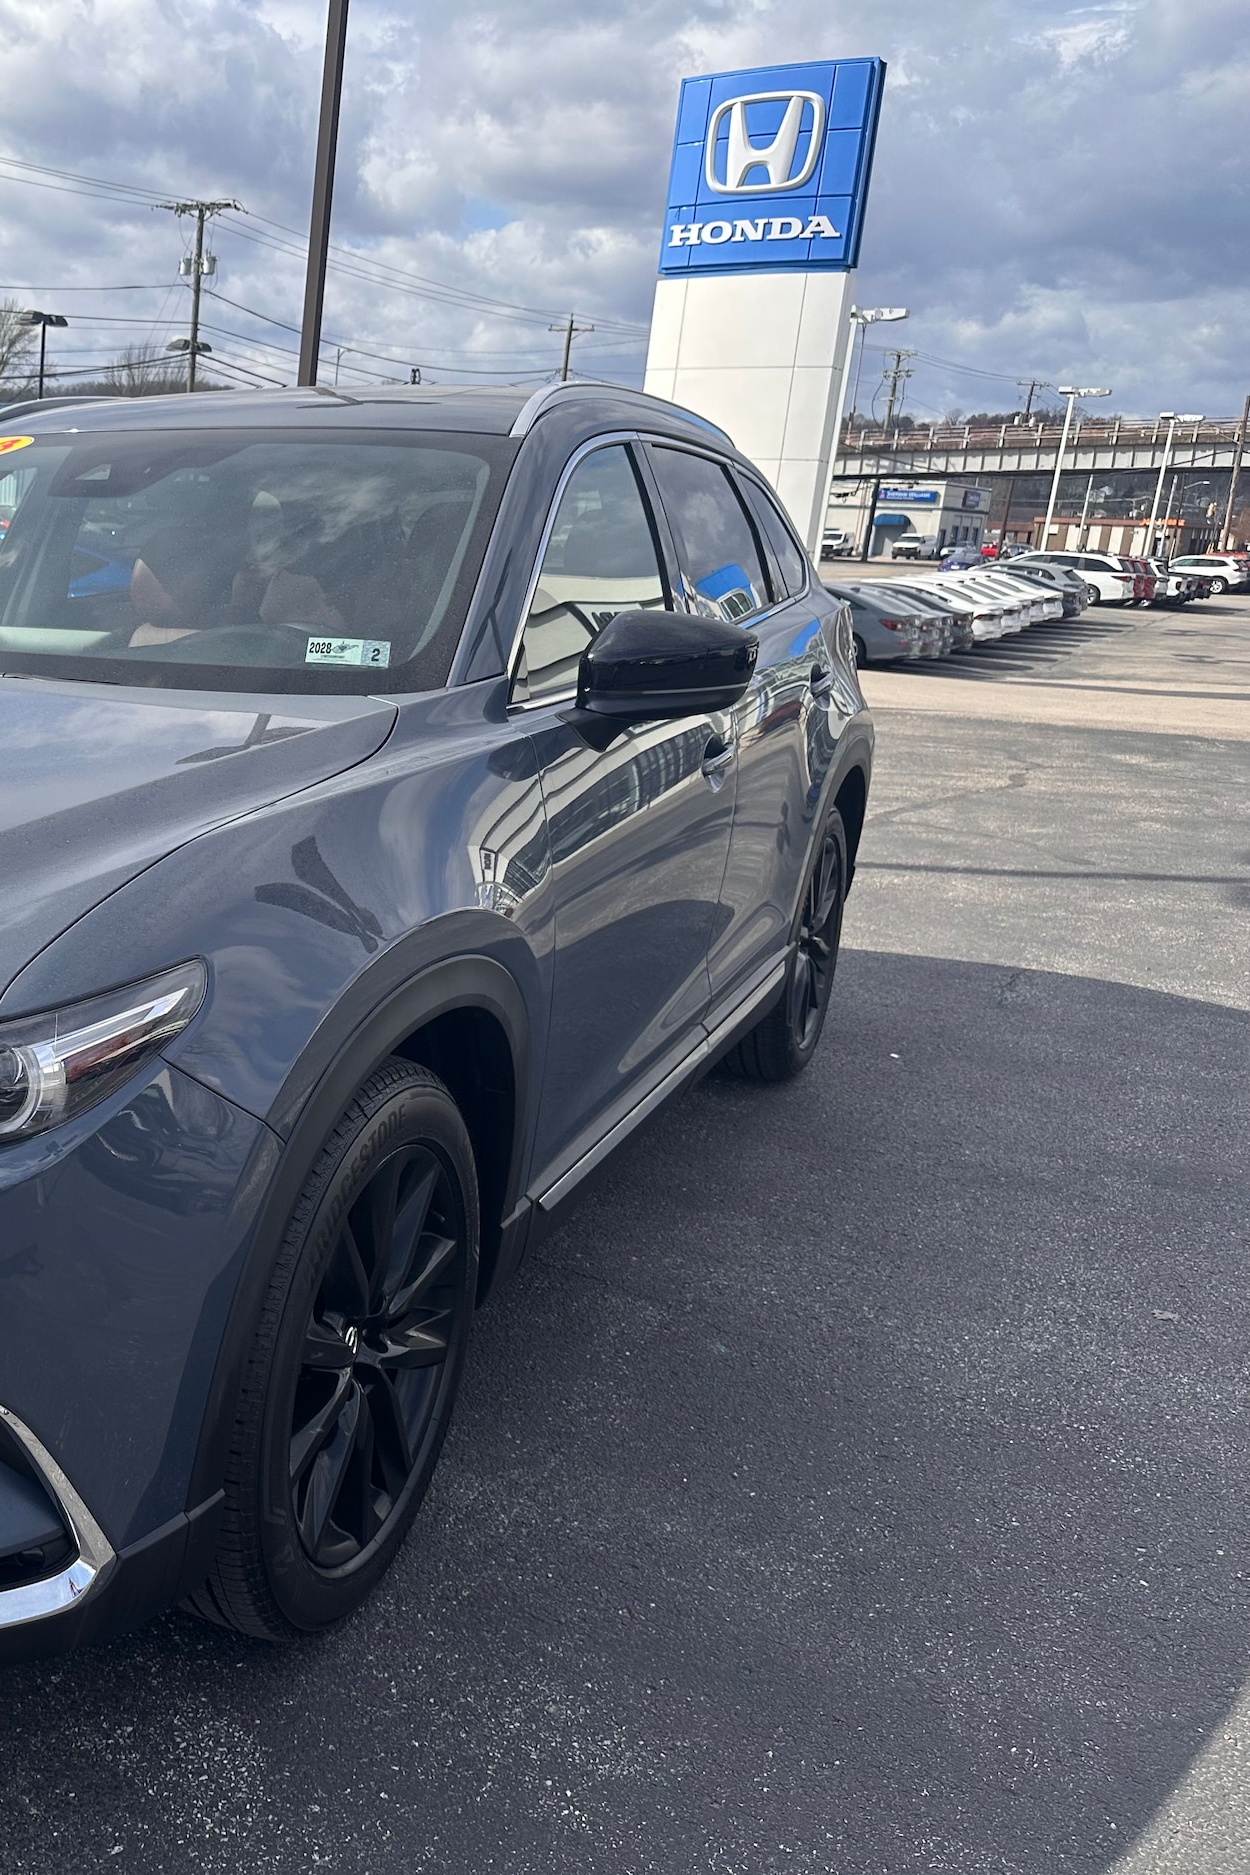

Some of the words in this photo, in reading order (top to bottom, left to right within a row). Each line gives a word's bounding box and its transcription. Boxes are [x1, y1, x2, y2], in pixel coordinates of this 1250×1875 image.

[668, 215, 840, 247] HONDA
[309, 642, 332, 654] 2028
[371, 648, 381, 662] 2
